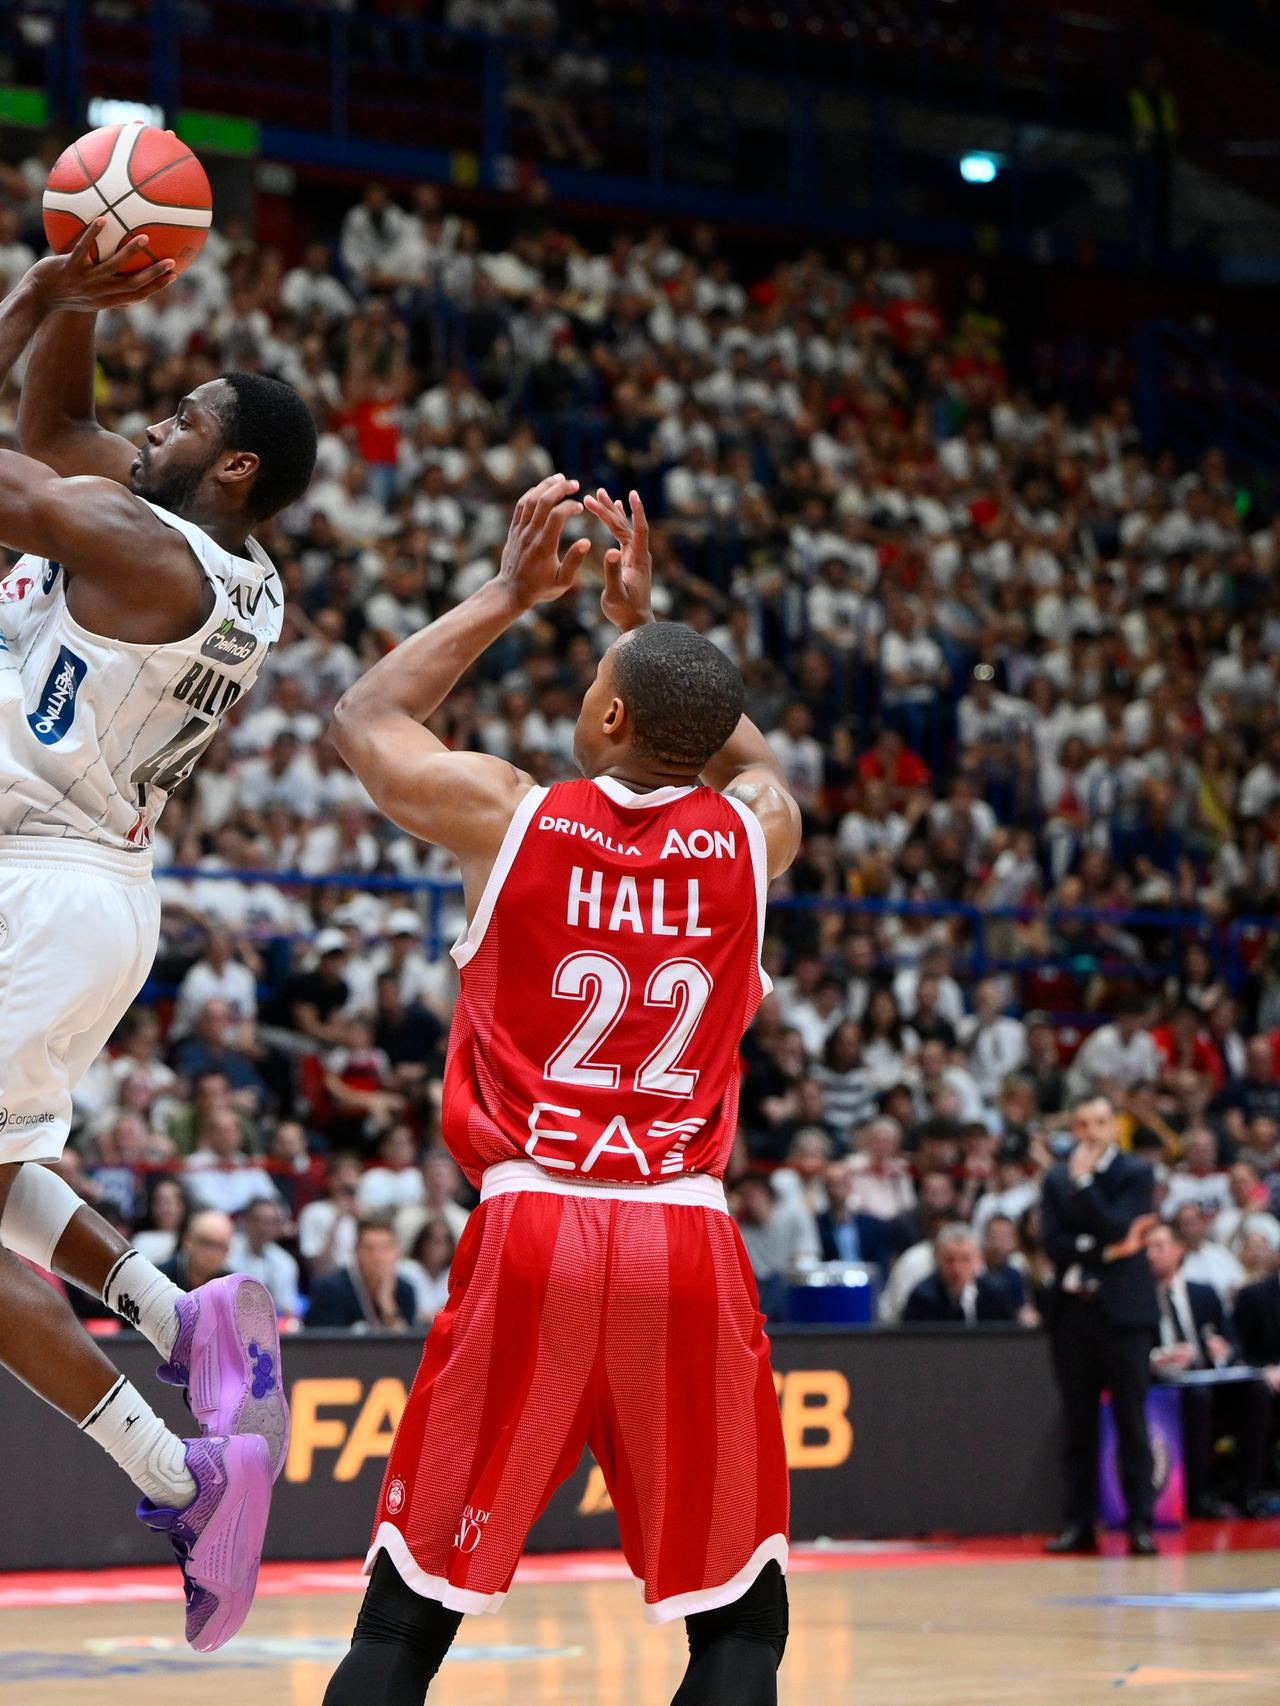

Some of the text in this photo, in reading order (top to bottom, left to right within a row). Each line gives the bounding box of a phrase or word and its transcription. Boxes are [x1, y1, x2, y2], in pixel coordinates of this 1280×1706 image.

[206, 632, 252, 659] Melinda
[538, 815, 736, 860] DRIVALIA AON
[567, 865, 712, 937] HALL
[543, 950, 713, 1100] 22
[524, 1102, 708, 1177] EA7
